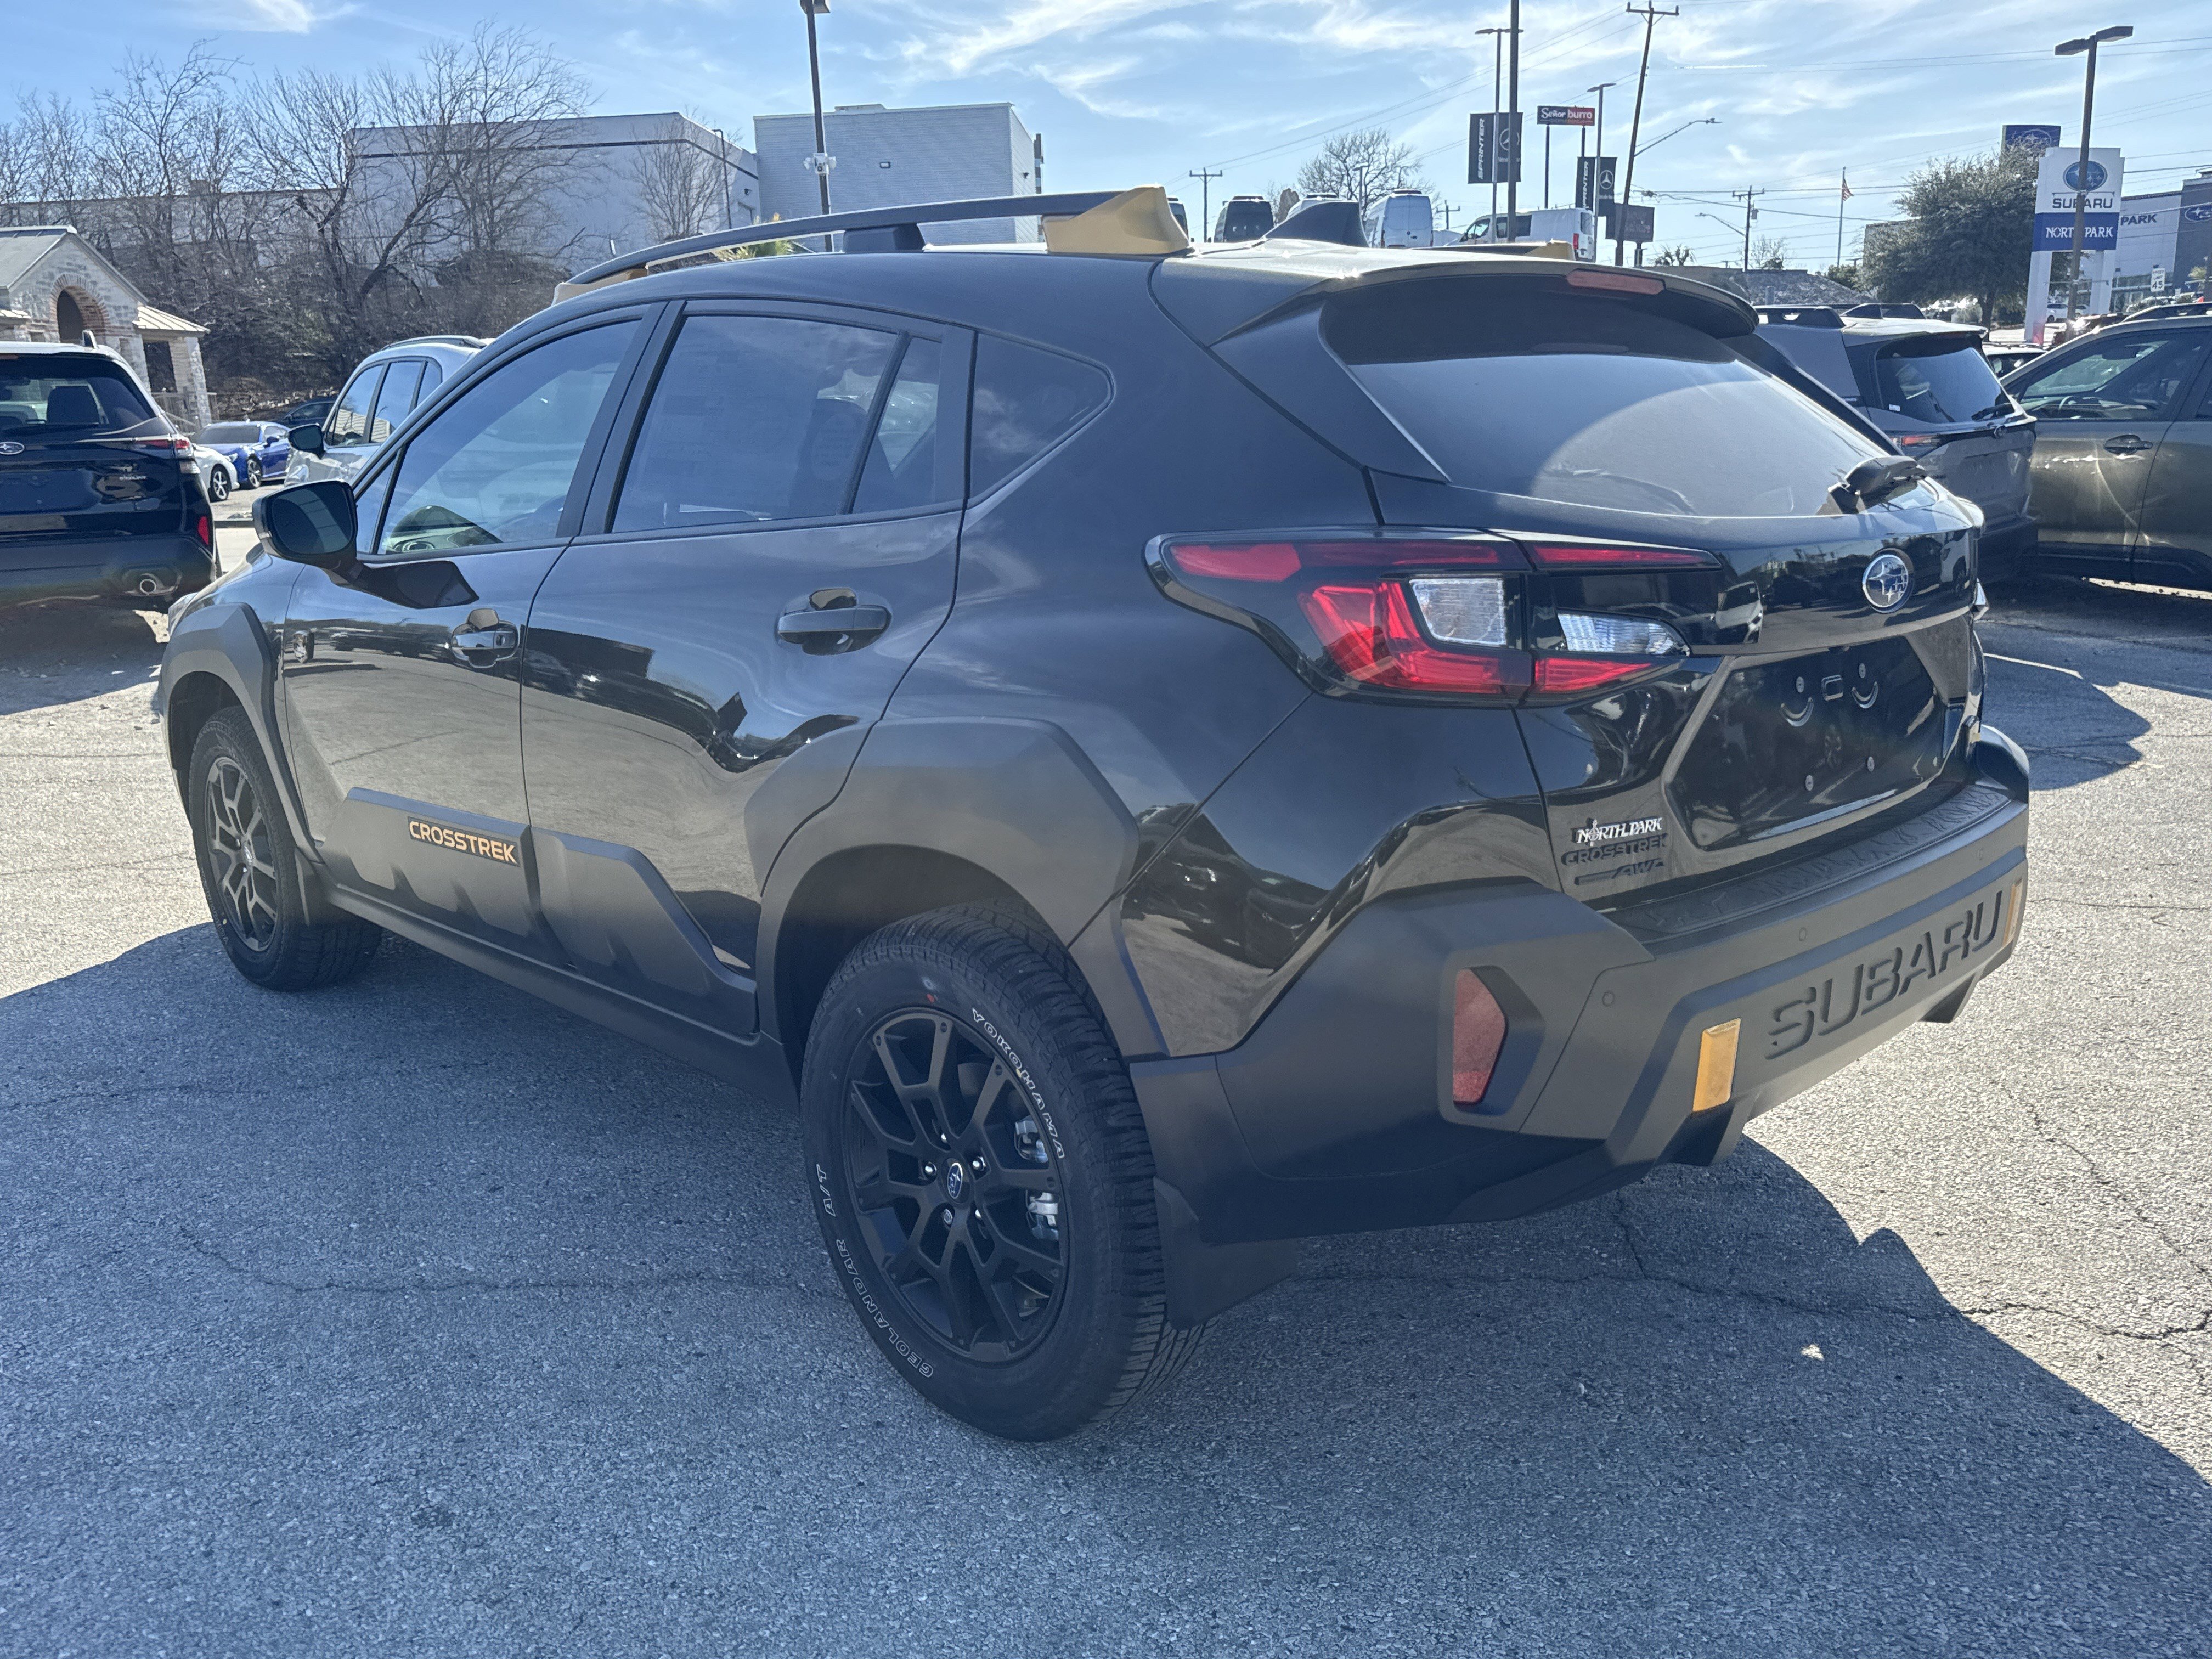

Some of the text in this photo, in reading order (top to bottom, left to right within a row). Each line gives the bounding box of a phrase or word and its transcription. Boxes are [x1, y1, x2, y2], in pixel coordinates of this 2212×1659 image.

[1541, 107, 1593, 119] Señor burro
[2045, 226, 2114, 238] NORT PARK
[2120, 213, 2157, 225] PARK
[2152, 280, 2163, 289] 45
[409, 821, 518, 864] CROSSTREK
[1576, 817, 1663, 846] NORTH PARK
[1562, 833, 1668, 865] CROSSTREK
[1765, 890, 2002, 1059] SUBARU
[972, 1008, 1065, 1158] YOKOHAMA
[816, 1164, 837, 1217] A/T
[836, 1239, 933, 1378] GEOLANDAR
